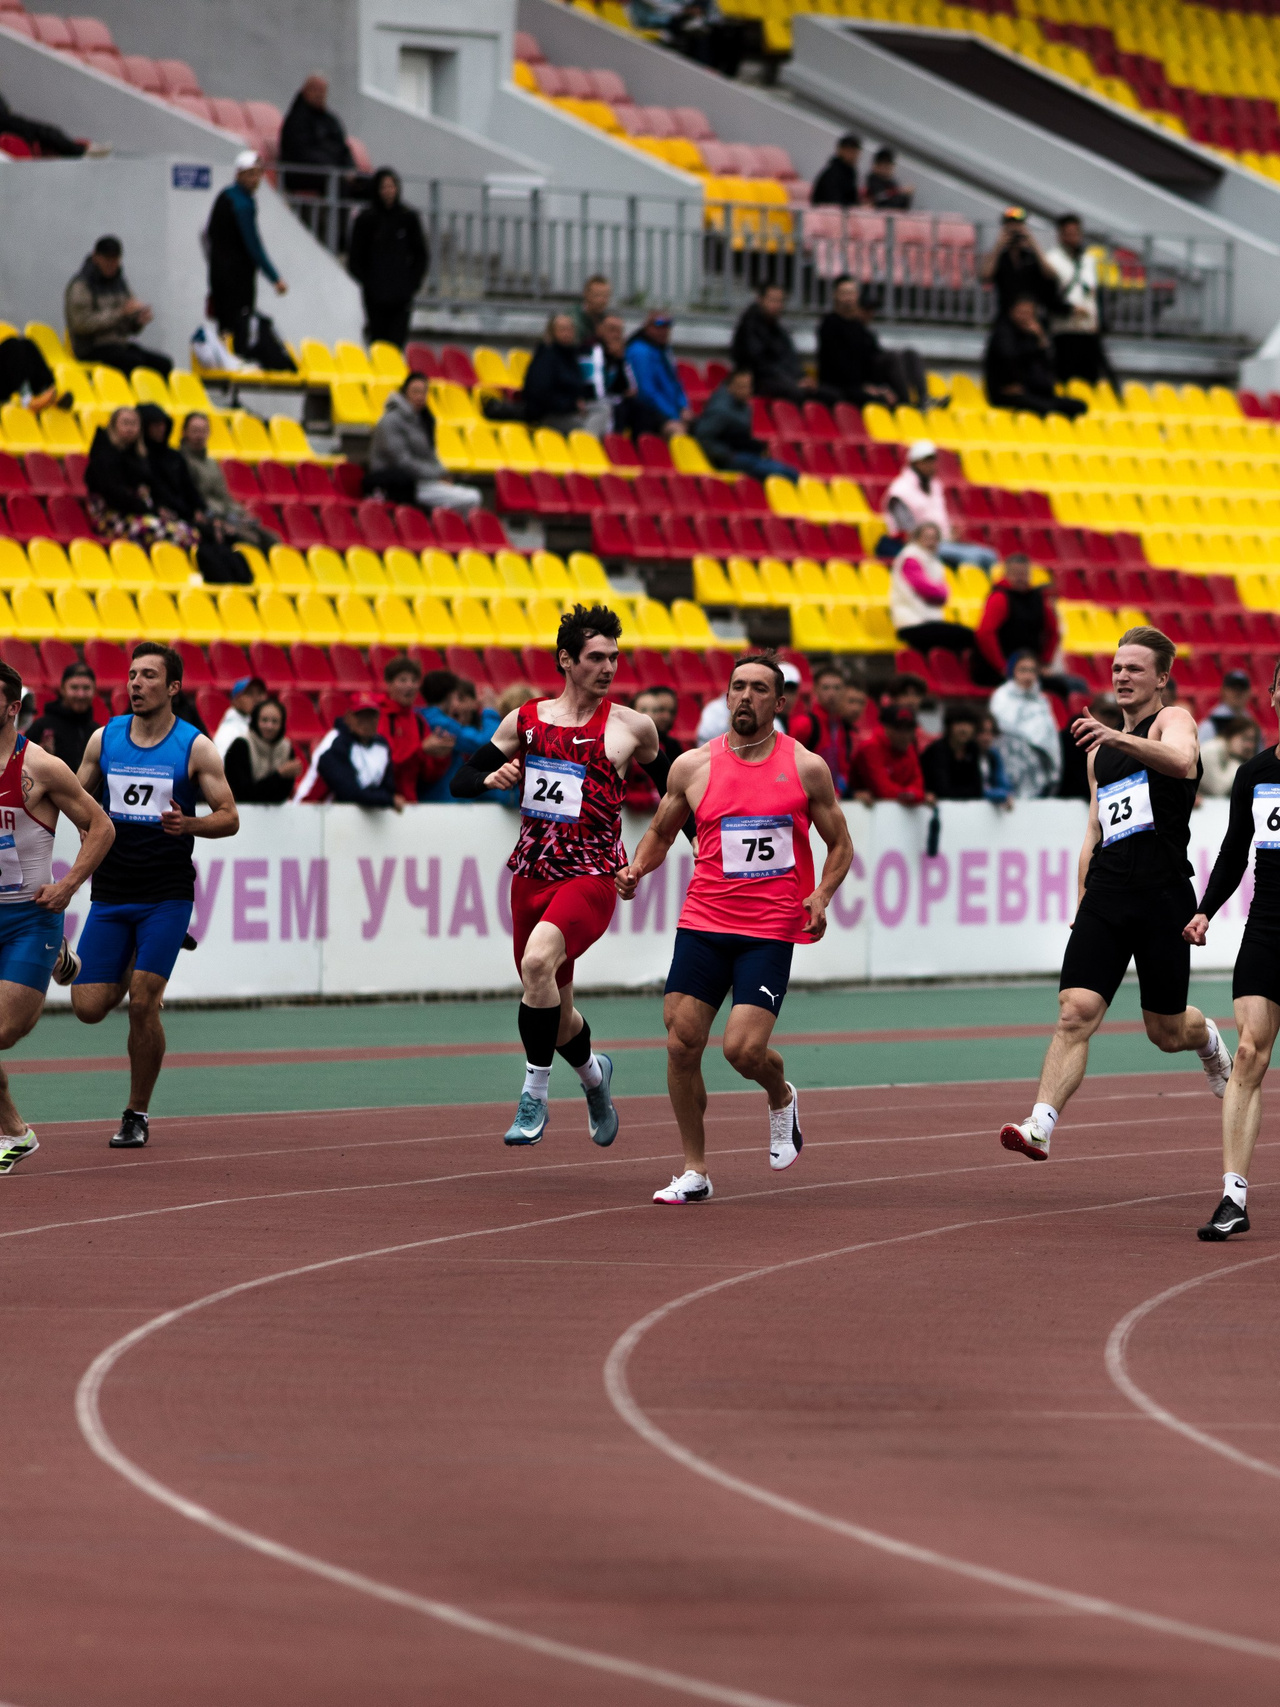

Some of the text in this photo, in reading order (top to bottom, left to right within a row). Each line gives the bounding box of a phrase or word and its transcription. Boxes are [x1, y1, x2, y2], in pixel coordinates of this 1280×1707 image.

[123, 784, 154, 806] 67
[533, 778, 564, 804] 24
[1108, 796, 1133, 826] 23
[742, 836, 775, 862] 75
